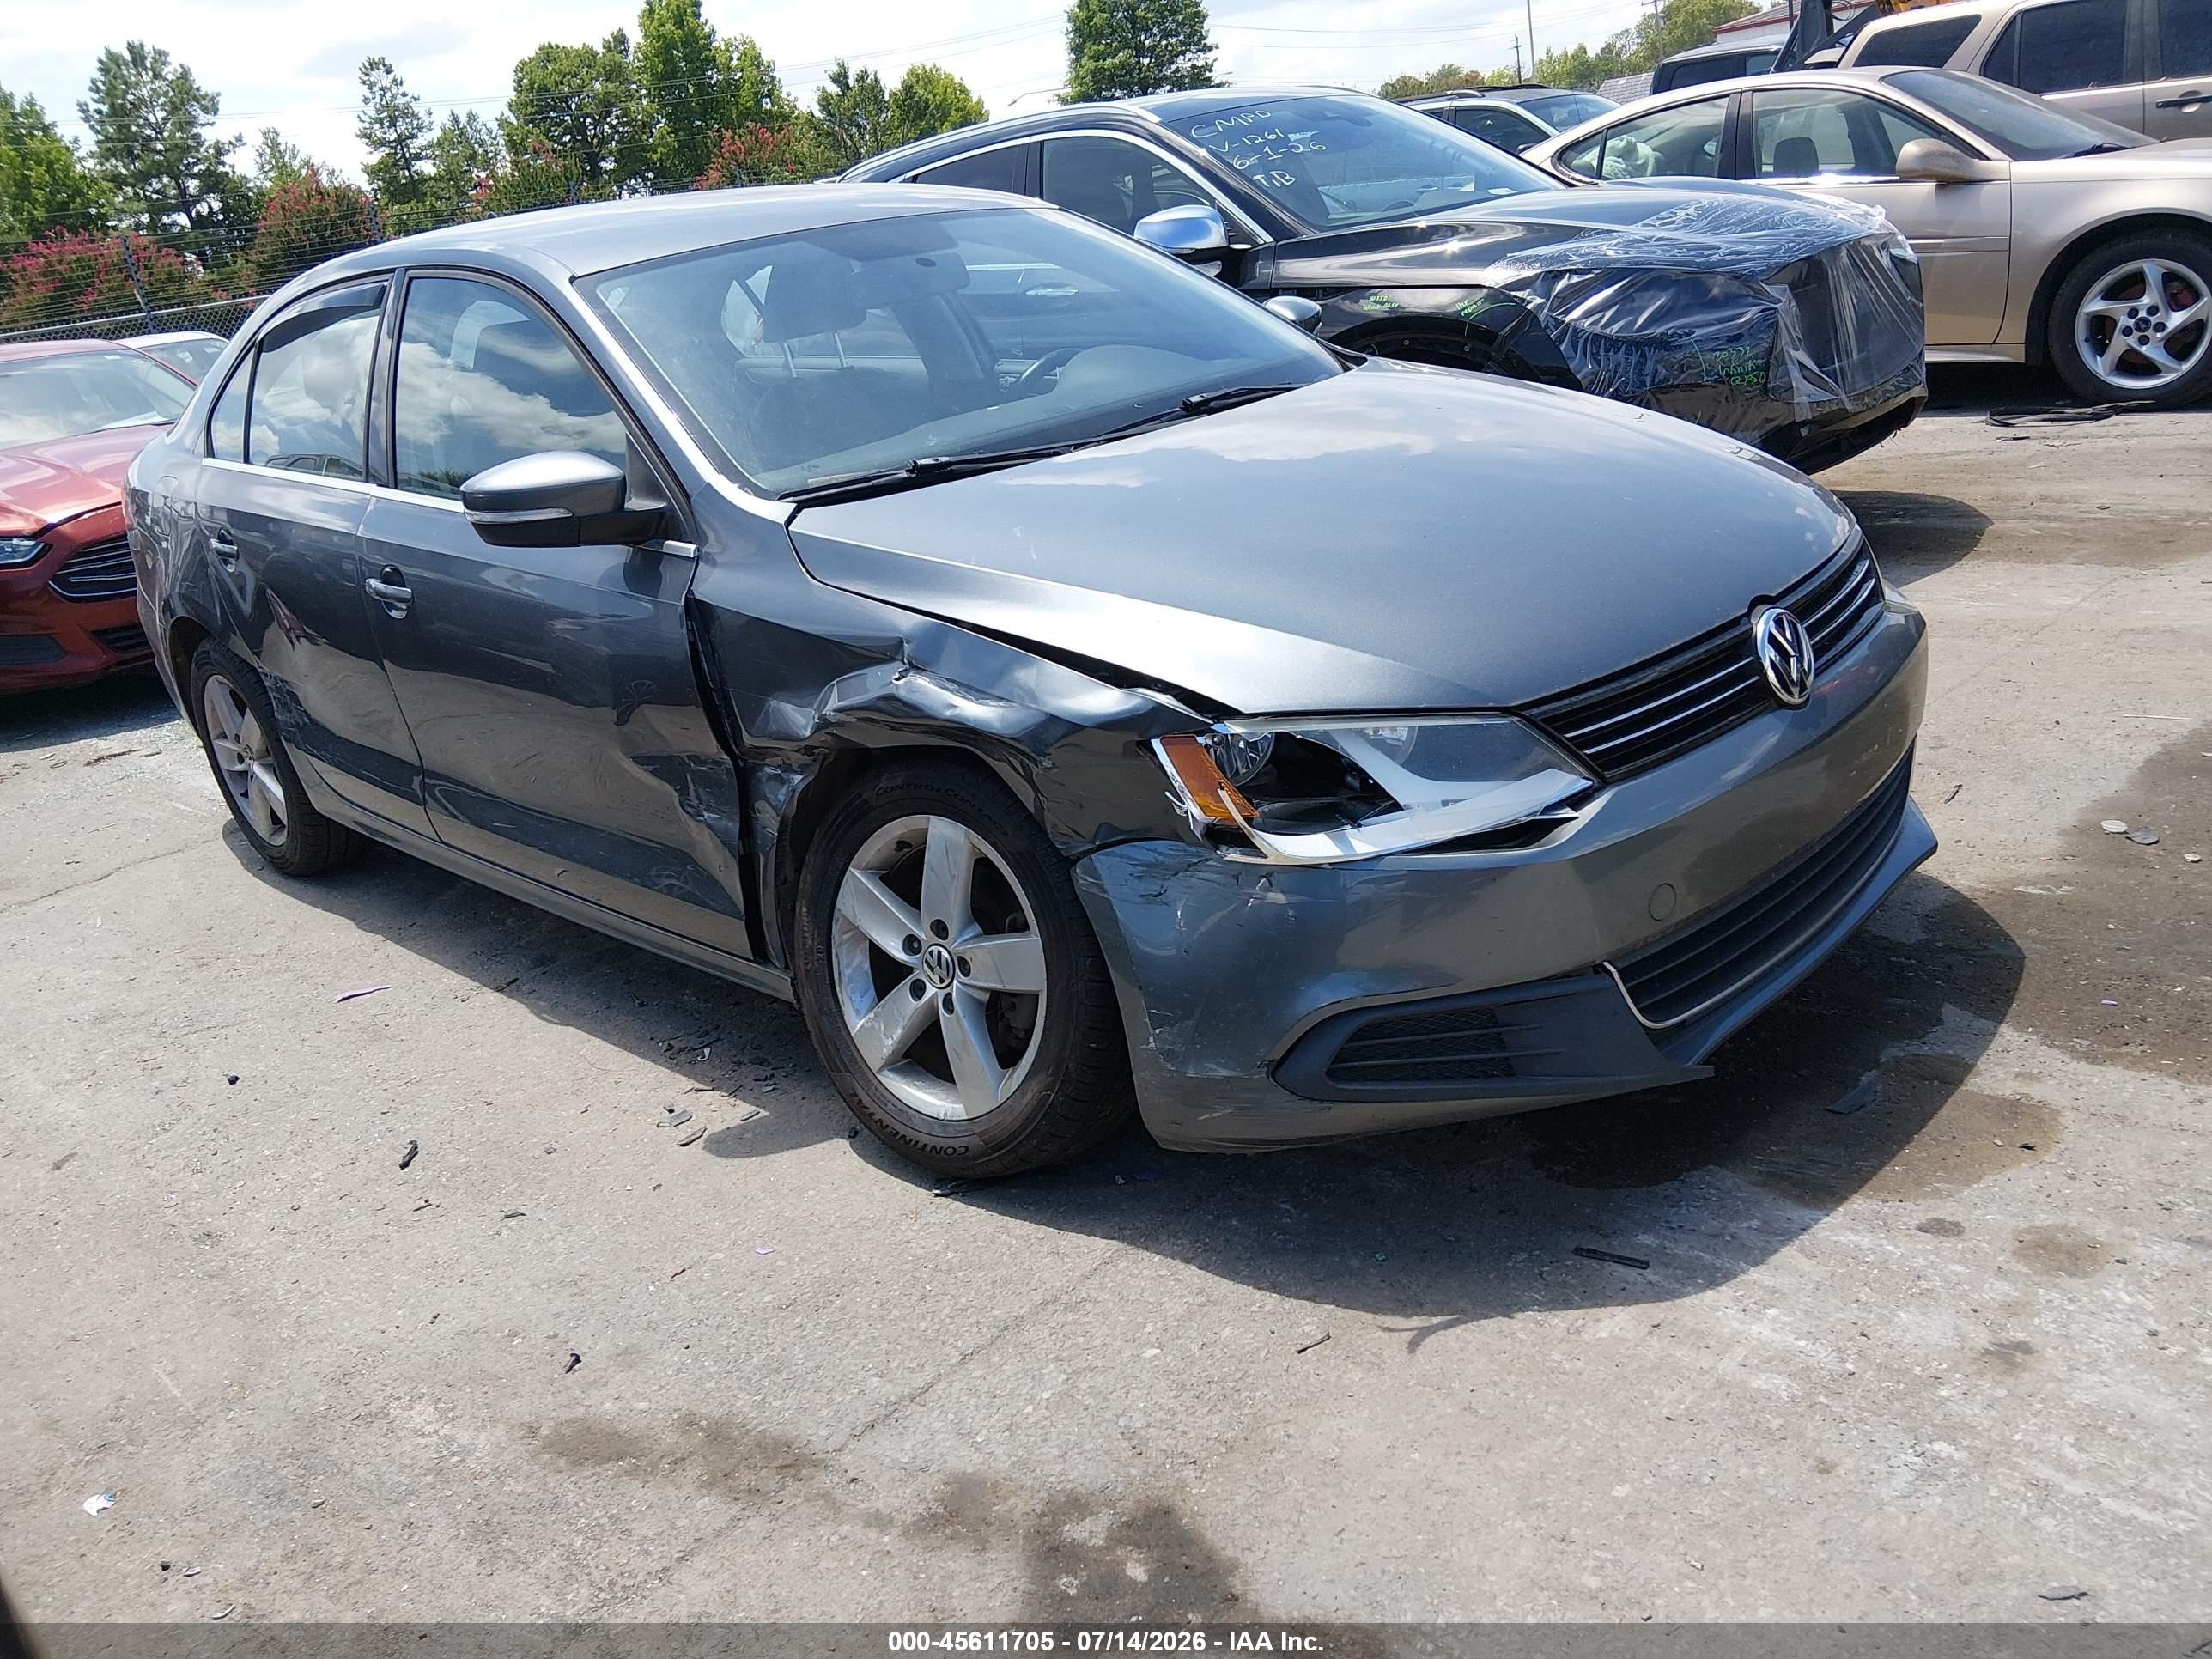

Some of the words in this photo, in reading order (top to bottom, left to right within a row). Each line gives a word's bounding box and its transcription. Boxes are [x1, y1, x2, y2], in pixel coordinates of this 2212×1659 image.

[1190, 109, 1272, 139] CMPD
[1208, 128, 1285, 153] V-1261
[1232, 141, 1327, 170] 6-1-26
[846, 1086, 969, 1157] CONTINENTAL
